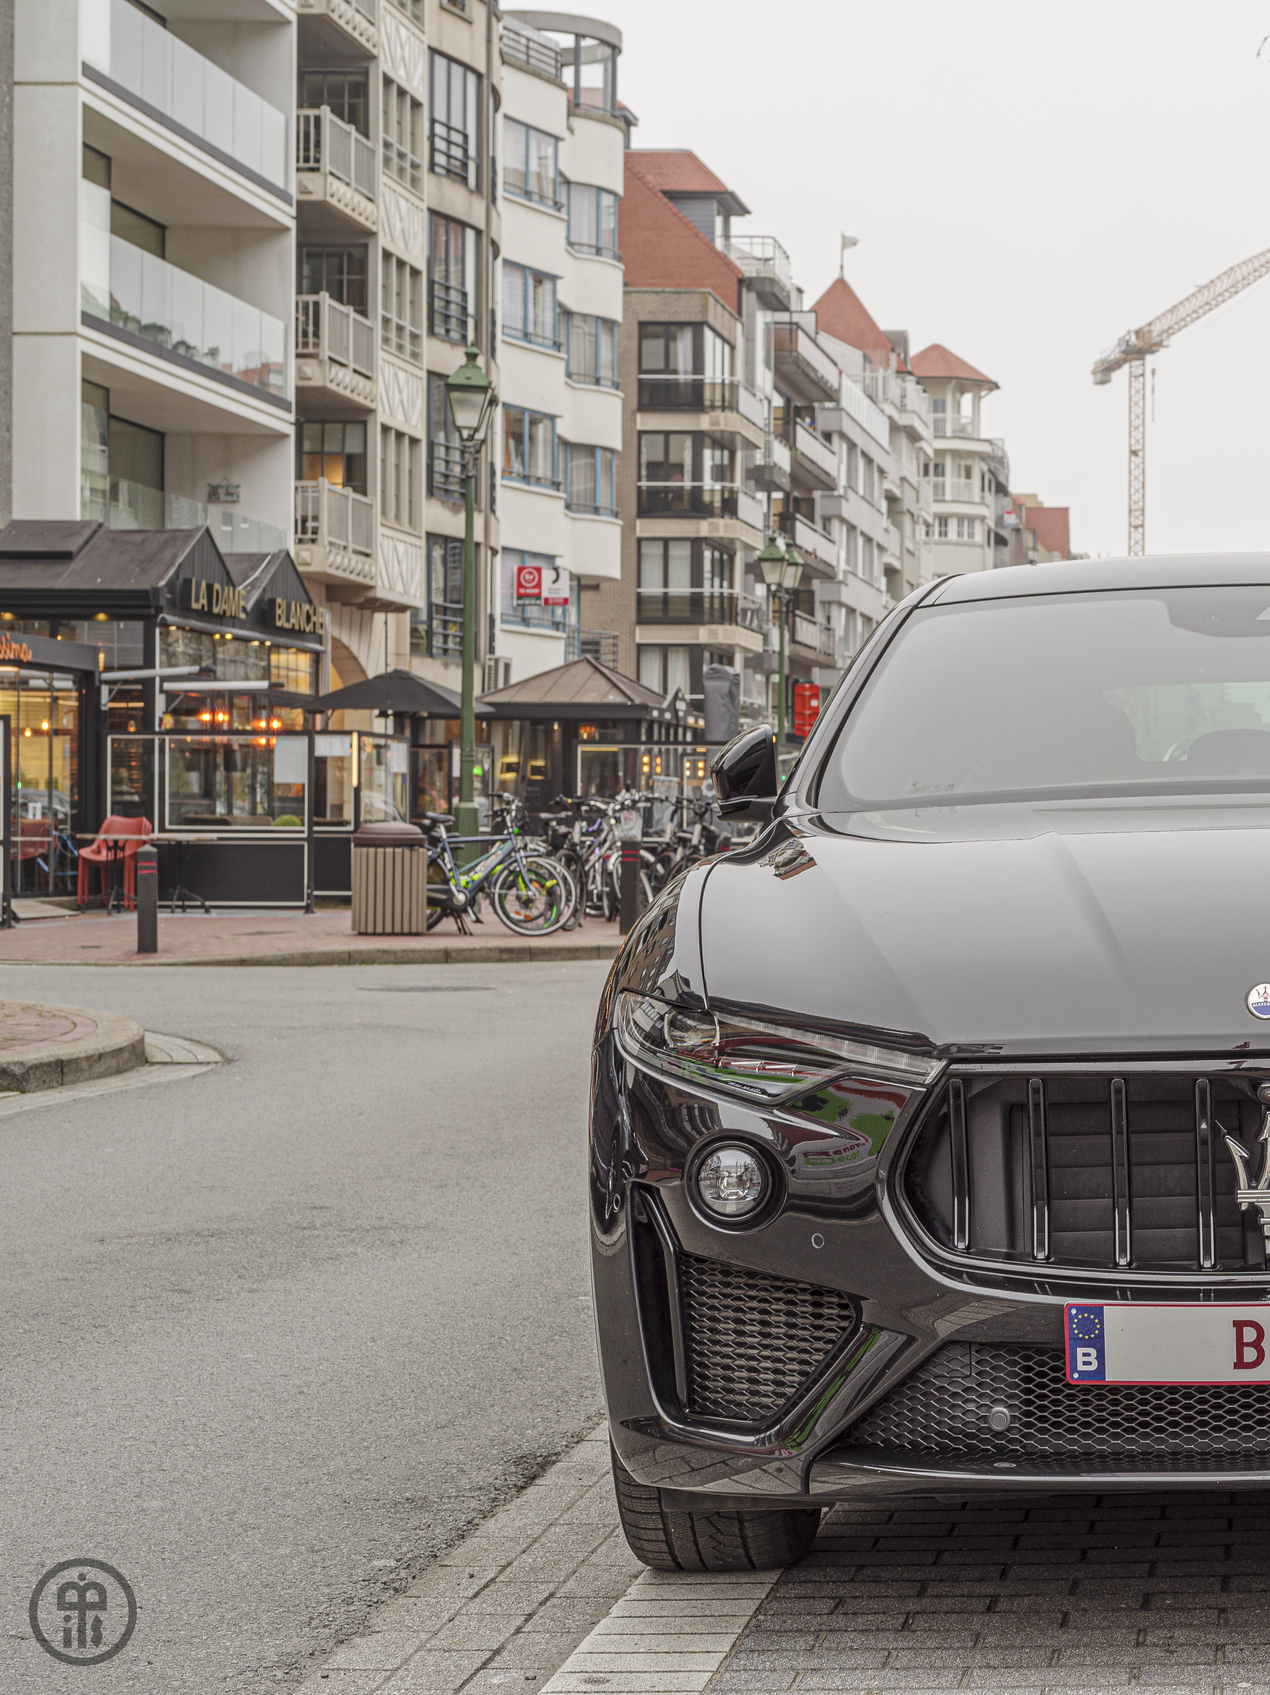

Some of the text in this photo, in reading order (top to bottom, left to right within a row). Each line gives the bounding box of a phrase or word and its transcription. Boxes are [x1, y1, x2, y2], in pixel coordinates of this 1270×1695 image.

[191, 577, 247, 620] LA DAME
[275, 597, 325, 635] BLANCHE
[1077, 1347, 1098, 1371] B
